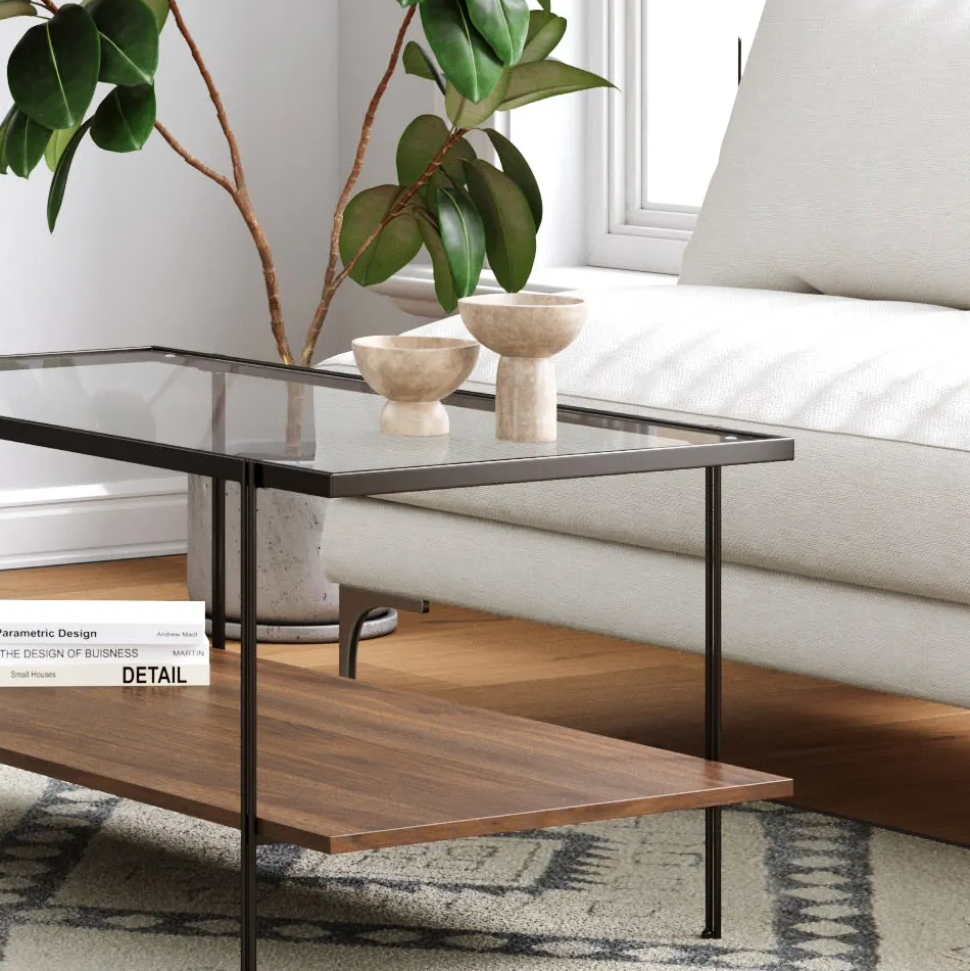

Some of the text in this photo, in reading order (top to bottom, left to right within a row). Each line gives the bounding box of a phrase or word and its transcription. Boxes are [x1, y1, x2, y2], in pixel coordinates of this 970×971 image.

[58, 628, 97, 640] Design
[0, 648, 139, 659] THE DESIGN OF BUISNESS
[10, 670, 57, 679] Small Houses
[121, 666, 187, 684] DETAIL
